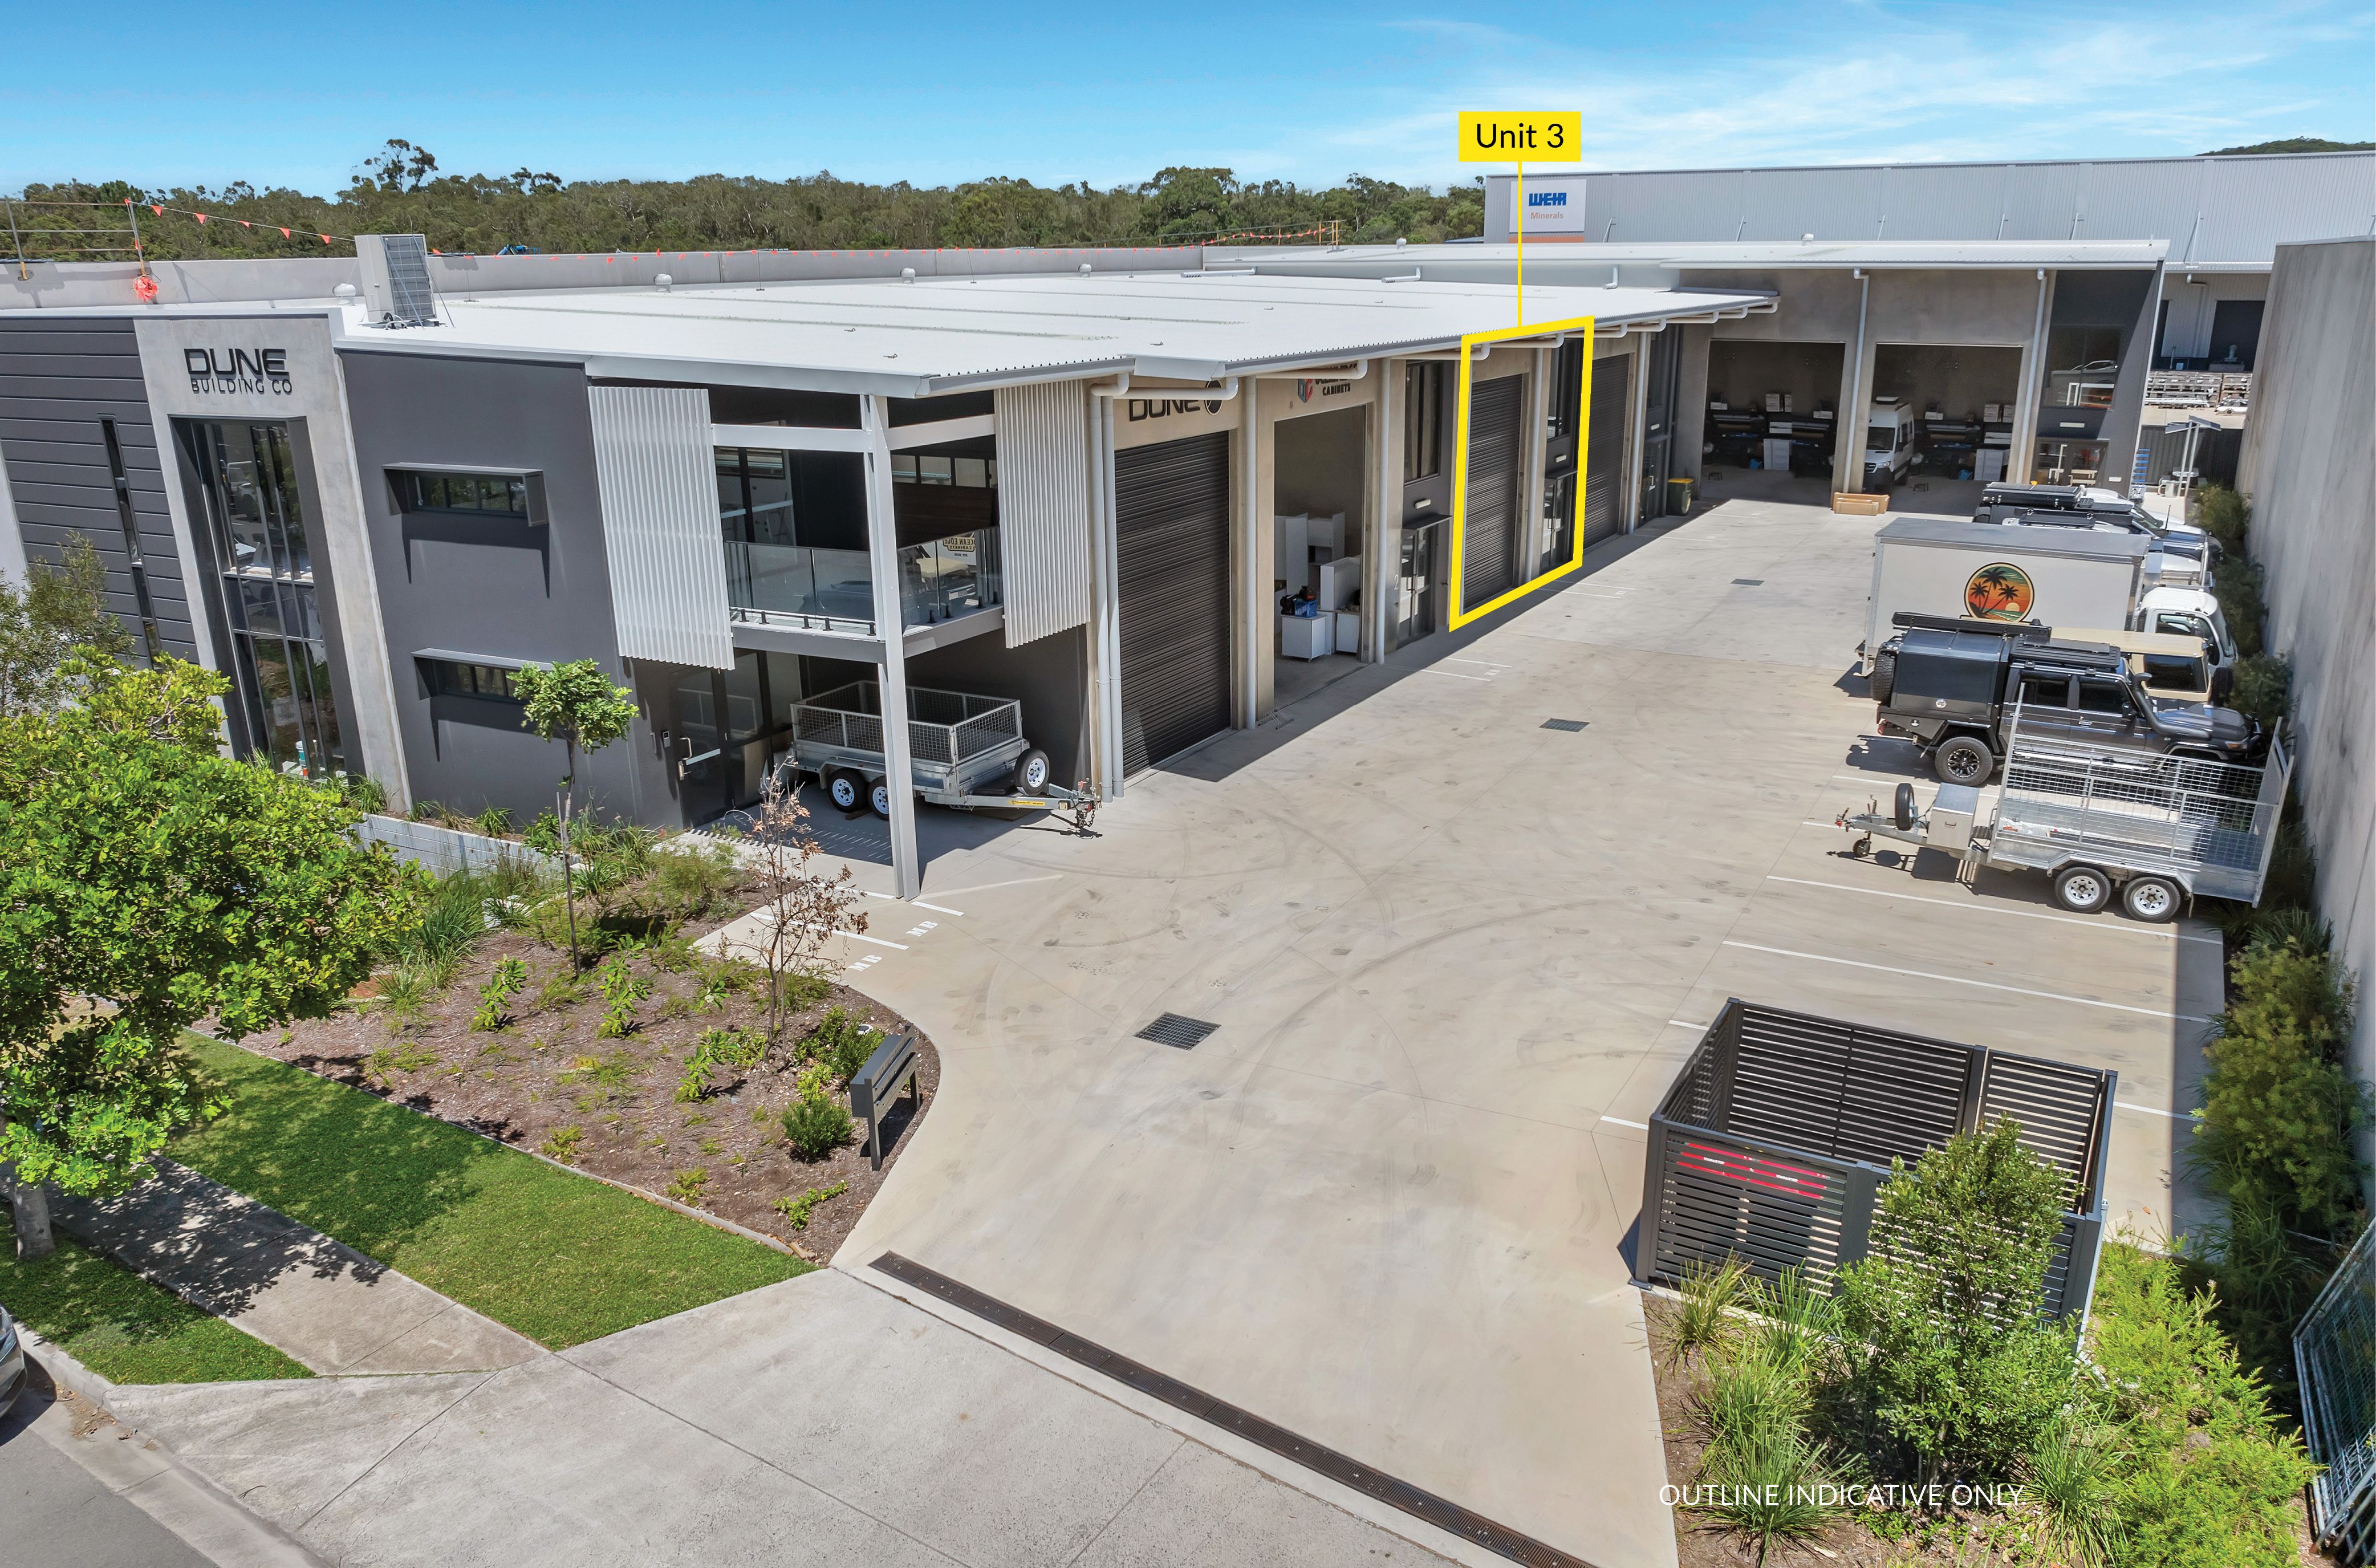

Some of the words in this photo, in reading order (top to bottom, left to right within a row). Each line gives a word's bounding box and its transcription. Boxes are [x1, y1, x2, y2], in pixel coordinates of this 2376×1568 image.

[1529, 192, 1567, 206] WEIR
[184, 348, 290, 375] DUNE
[191, 377, 265, 393] BUILDING
[272, 379, 293, 393] CO
[1322, 383, 1351, 396] CABINETS
[1394, 574, 1399, 591] 2
[905, 921, 939, 937] MB
[847, 954, 883, 972] MB
